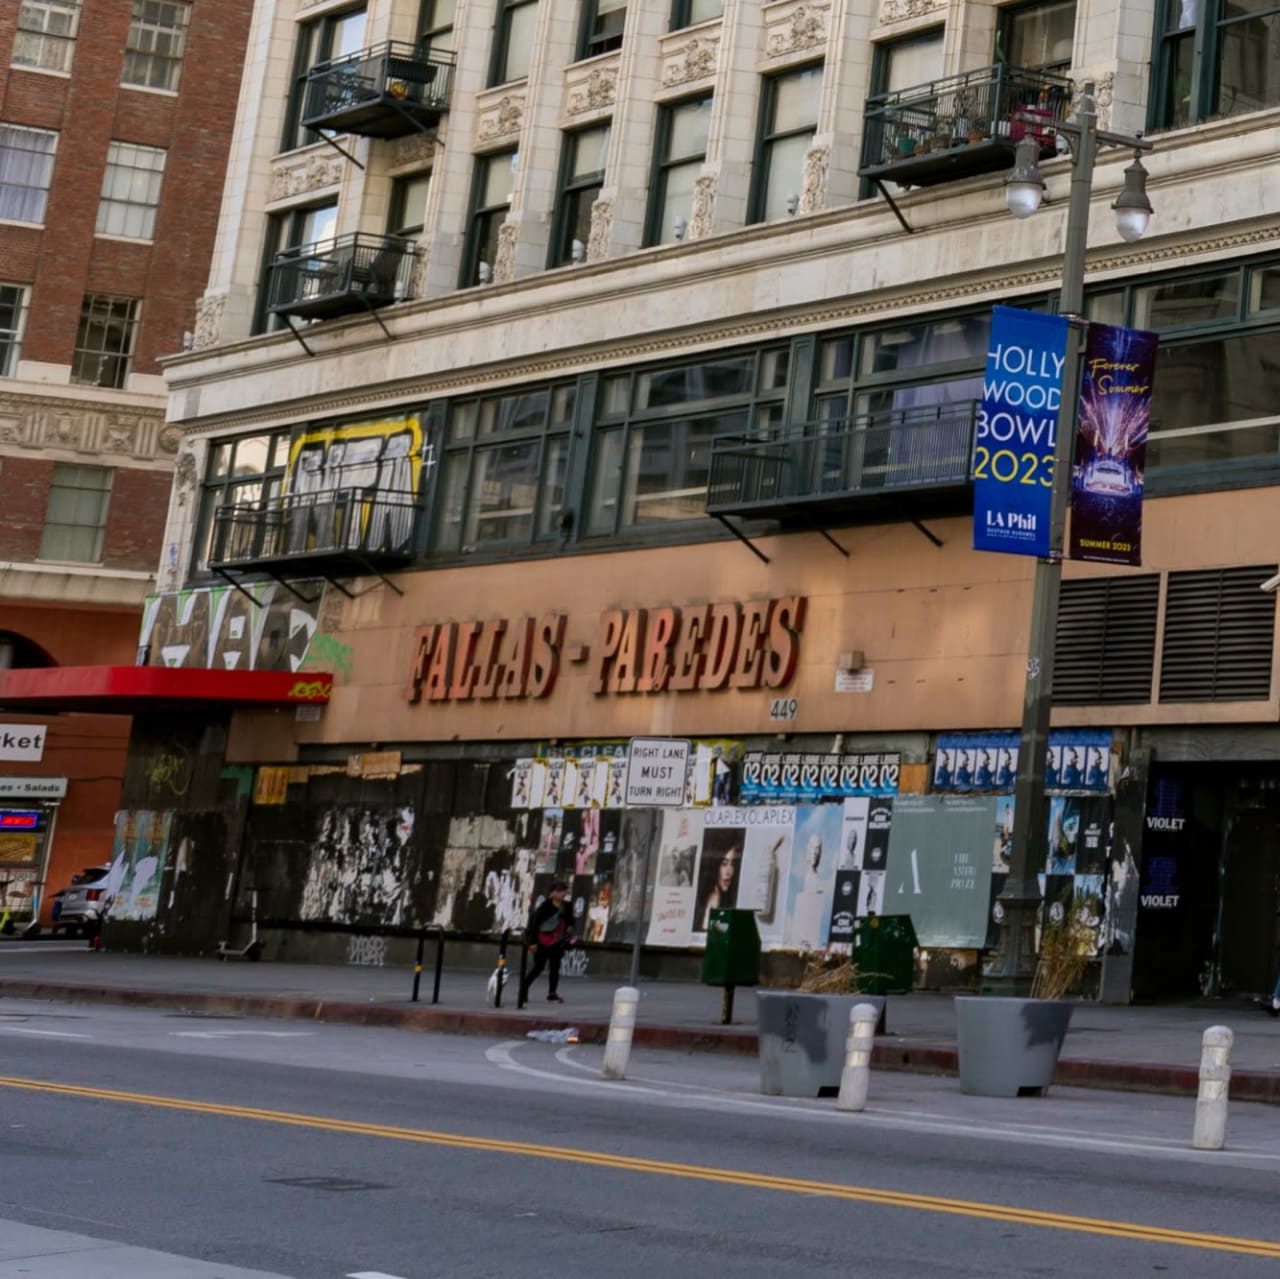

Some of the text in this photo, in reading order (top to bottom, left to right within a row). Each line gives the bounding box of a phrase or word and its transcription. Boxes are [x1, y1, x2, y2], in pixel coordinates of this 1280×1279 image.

[987, 343, 1066, 380] HOLLY
[1089, 357, 1140, 378] Forever
[1097, 375, 1149, 396] Summer
[983, 380, 1062, 411] WOOD
[977, 411, 1057, 448] BOWL
[974, 447, 1056, 488] 2023
[986, 509, 1037, 531] LA Phil
[1080, 538, 1110, 550] SUMMER
[405, 615, 567, 704] FALLAS
[594, 596, 808, 697] PAREDES
[770, 698, 797, 720] 449
[0, 732, 42, 749] ket
[632, 746, 685, 760] RIGHT LANE
[641, 766, 673, 779] MUST
[24, 783, 60, 793] Salads
[629, 786, 682, 798] TURN RIGHT
[748, 808, 795, 825] OLAPLEX
[1146, 816, 1186, 831] VIOLET
[1140, 894, 1180, 908] VIOLET
